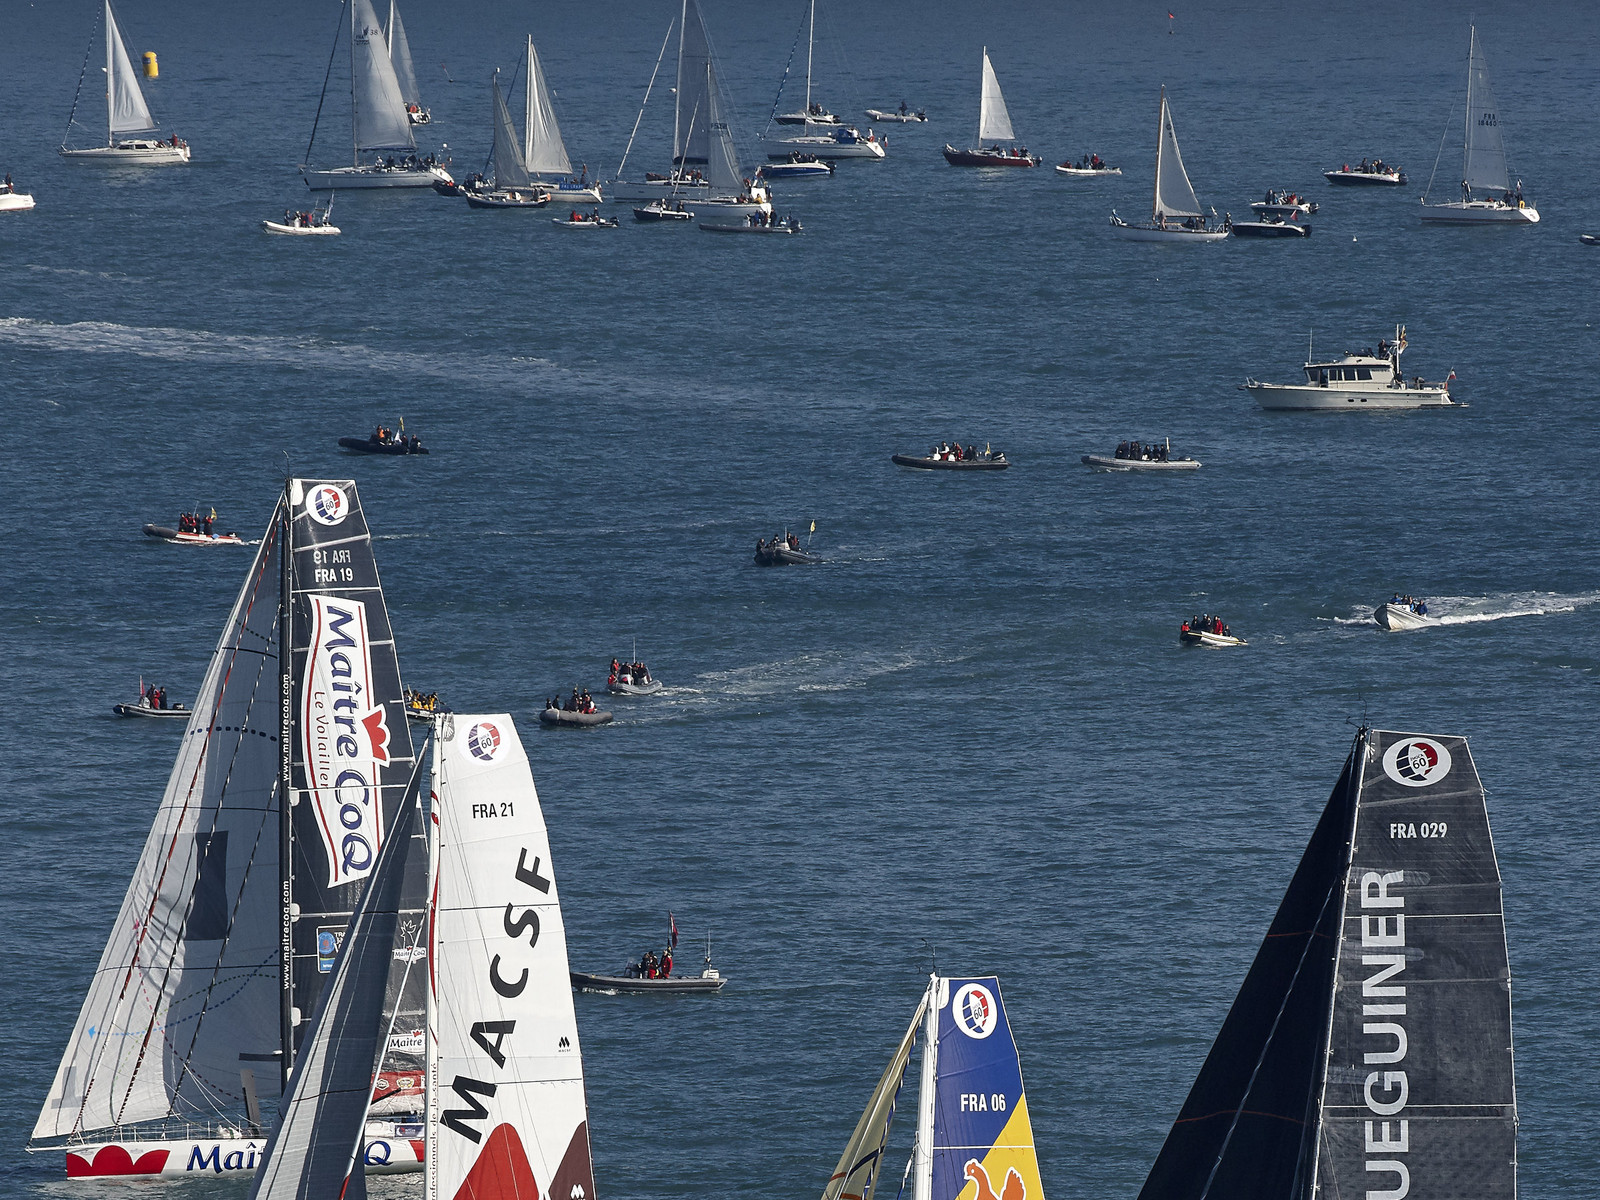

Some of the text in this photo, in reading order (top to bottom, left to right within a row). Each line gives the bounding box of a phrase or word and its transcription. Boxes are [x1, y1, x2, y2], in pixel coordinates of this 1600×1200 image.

[325, 500, 335, 511] 60
[314, 567, 353, 583] FRA 19
[324, 605, 363, 758] Maître
[314, 691, 325, 714] Le
[282, 674, 290, 782] www.maitrecoq.com
[481, 737, 493, 749] 60
[1412, 757, 1427, 770] 60
[472, 802, 514, 819] FRA 21
[1390, 822, 1448, 839] FRA 029
[282, 880, 290, 990] www.maitrecoq.com
[439, 847, 551, 1144] MACSF
[973, 1006, 983, 1020] 60
[960, 1093, 1006, 1112] FRA 06
